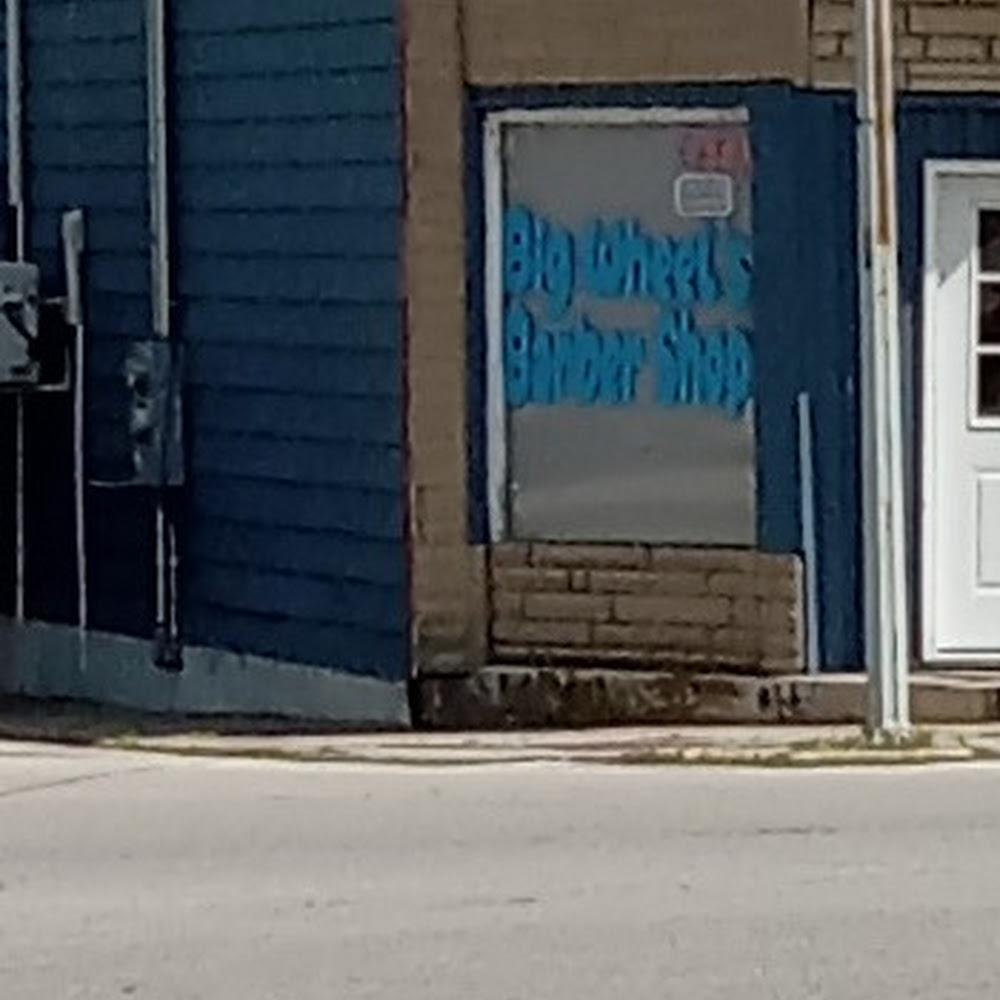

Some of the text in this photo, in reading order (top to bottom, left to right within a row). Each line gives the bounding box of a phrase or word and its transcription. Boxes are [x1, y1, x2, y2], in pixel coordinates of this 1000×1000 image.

[504, 202, 574, 322] Big
[504, 302, 752, 418] Barber Shop
